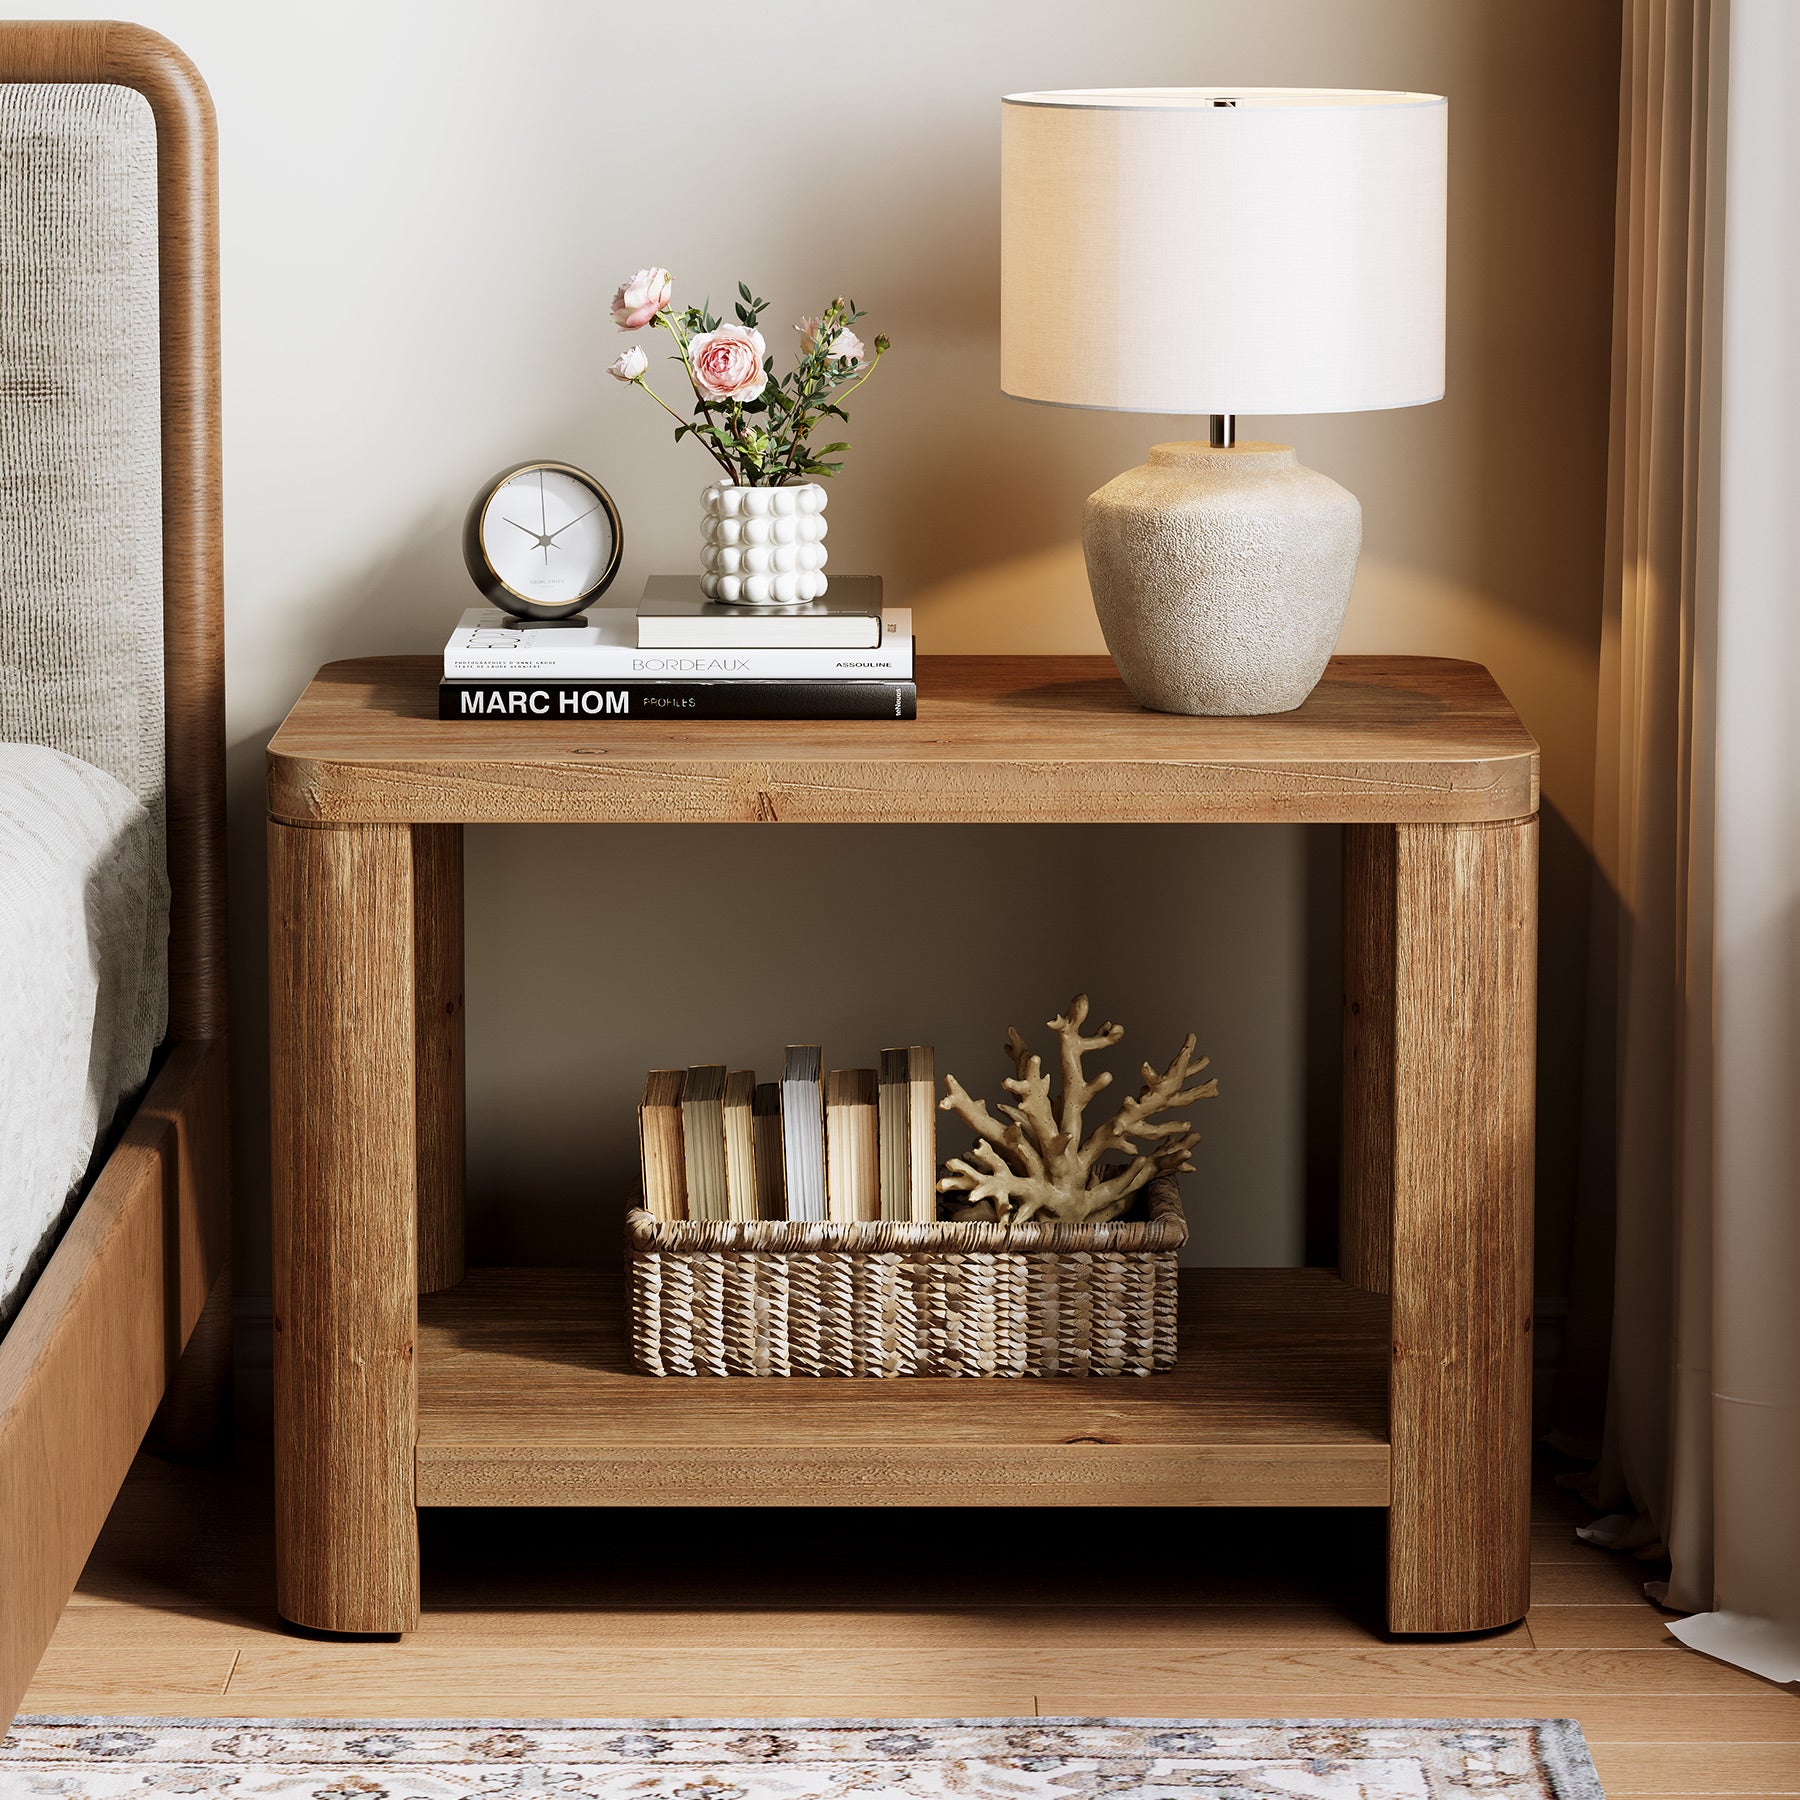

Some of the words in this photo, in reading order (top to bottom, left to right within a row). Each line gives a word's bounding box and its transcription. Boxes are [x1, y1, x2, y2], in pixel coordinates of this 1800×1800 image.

[632, 658, 751, 671] BORDEAUX
[460, 690, 550, 714] MARC
[559, 690, 630, 714] HOM
[643, 697, 696, 708] PROFILES
